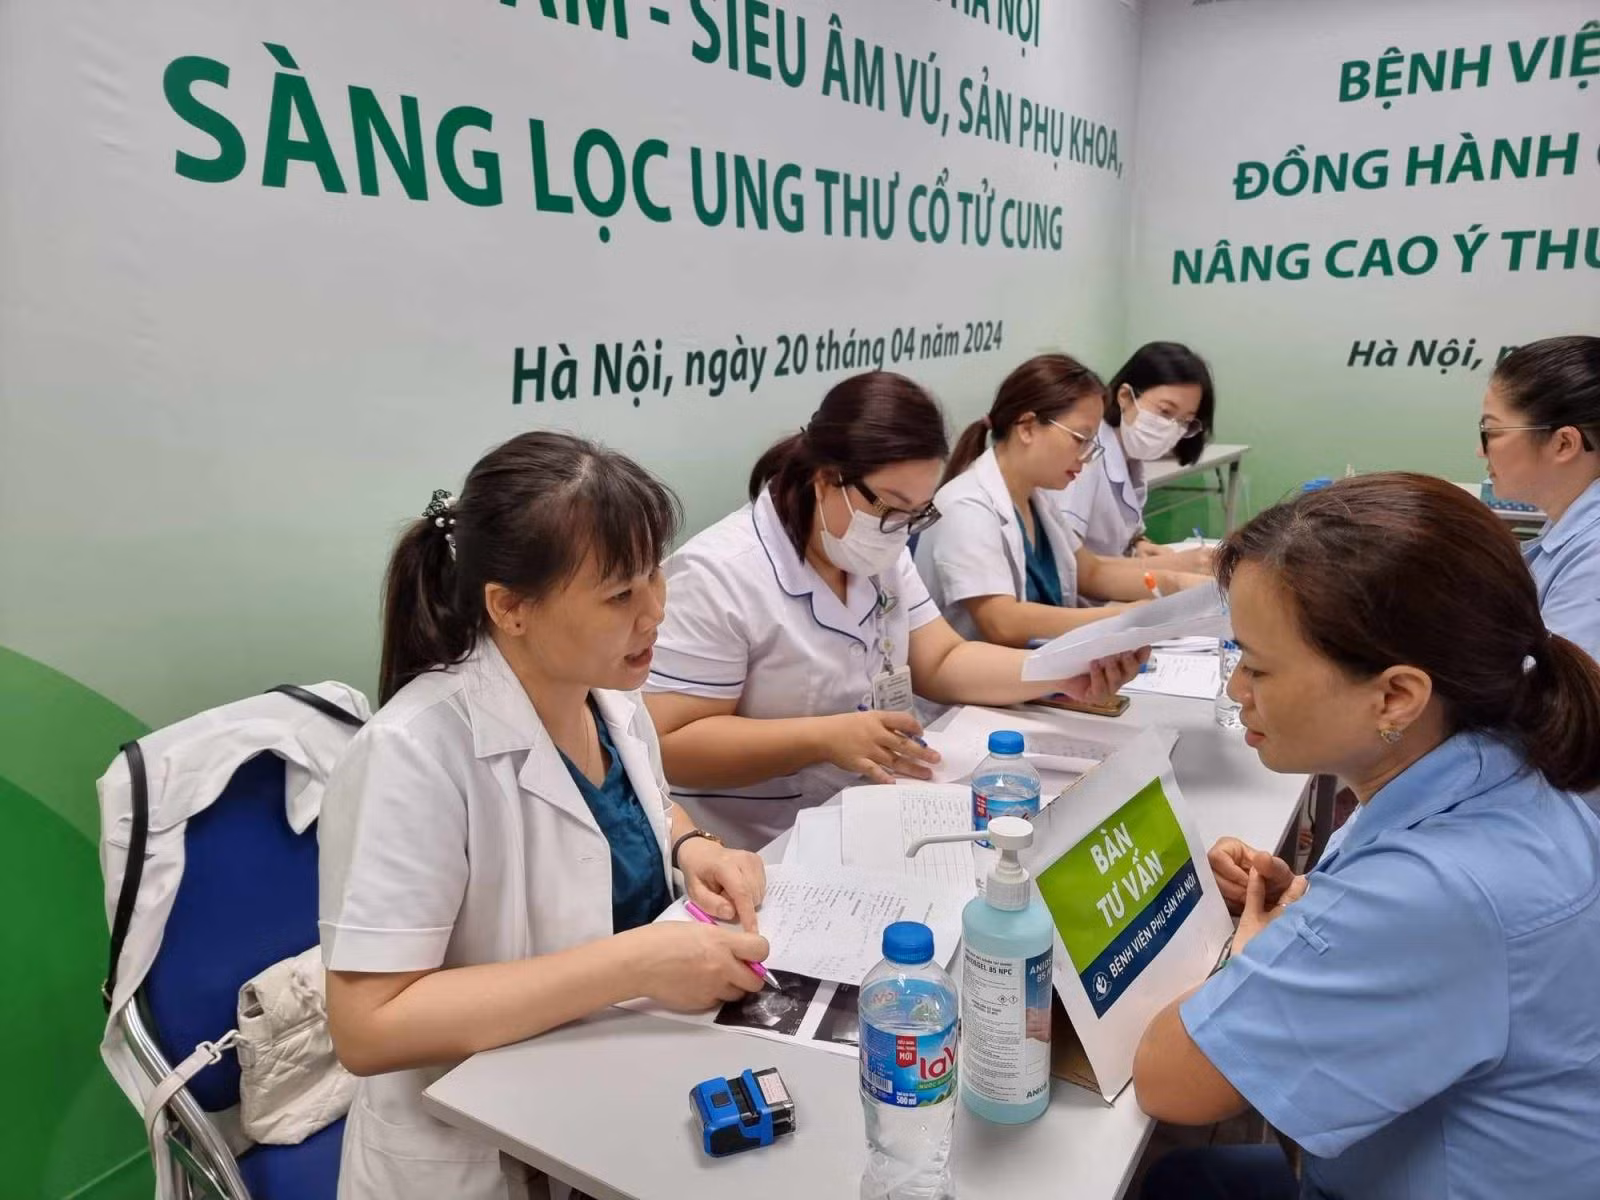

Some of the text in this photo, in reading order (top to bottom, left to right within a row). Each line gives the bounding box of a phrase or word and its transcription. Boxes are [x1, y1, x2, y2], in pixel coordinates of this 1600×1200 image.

[822, 13, 885, 112] ÂM
[895, 52, 949, 137] VÚ,
[959, 66, 1012, 144] SẢN
[1019, 98, 1064, 170] PHỤ
[1069, 115, 1122, 179] KHOA,
[1339, 46, 1492, 110] BỆNH
[163, 42, 1063, 250] SÀNG LỌC UNG THƯ CỔ TỬ CUNG
[1233, 145, 1389, 200] ĐỒNG
[1405, 132, 1580, 186] HÀNH
[1172, 240, 1310, 285] NÂNG
[1325, 236, 1438, 278] CAO
[1453, 224, 1489, 273] Ý
[512, 319, 1003, 408] Hà Nội, ngày 20 tháng 04 năm 2024
[1347, 339, 1398, 367] Hà
[1407, 338, 1483, 374] Nội,
[1090, 822, 1134, 875] BÀN
[1096, 848, 1164, 928] TƯ VẤN
[1109, 872, 1196, 979] BỆNH VIỆN PHỤ SẢN HÀ NỘI
